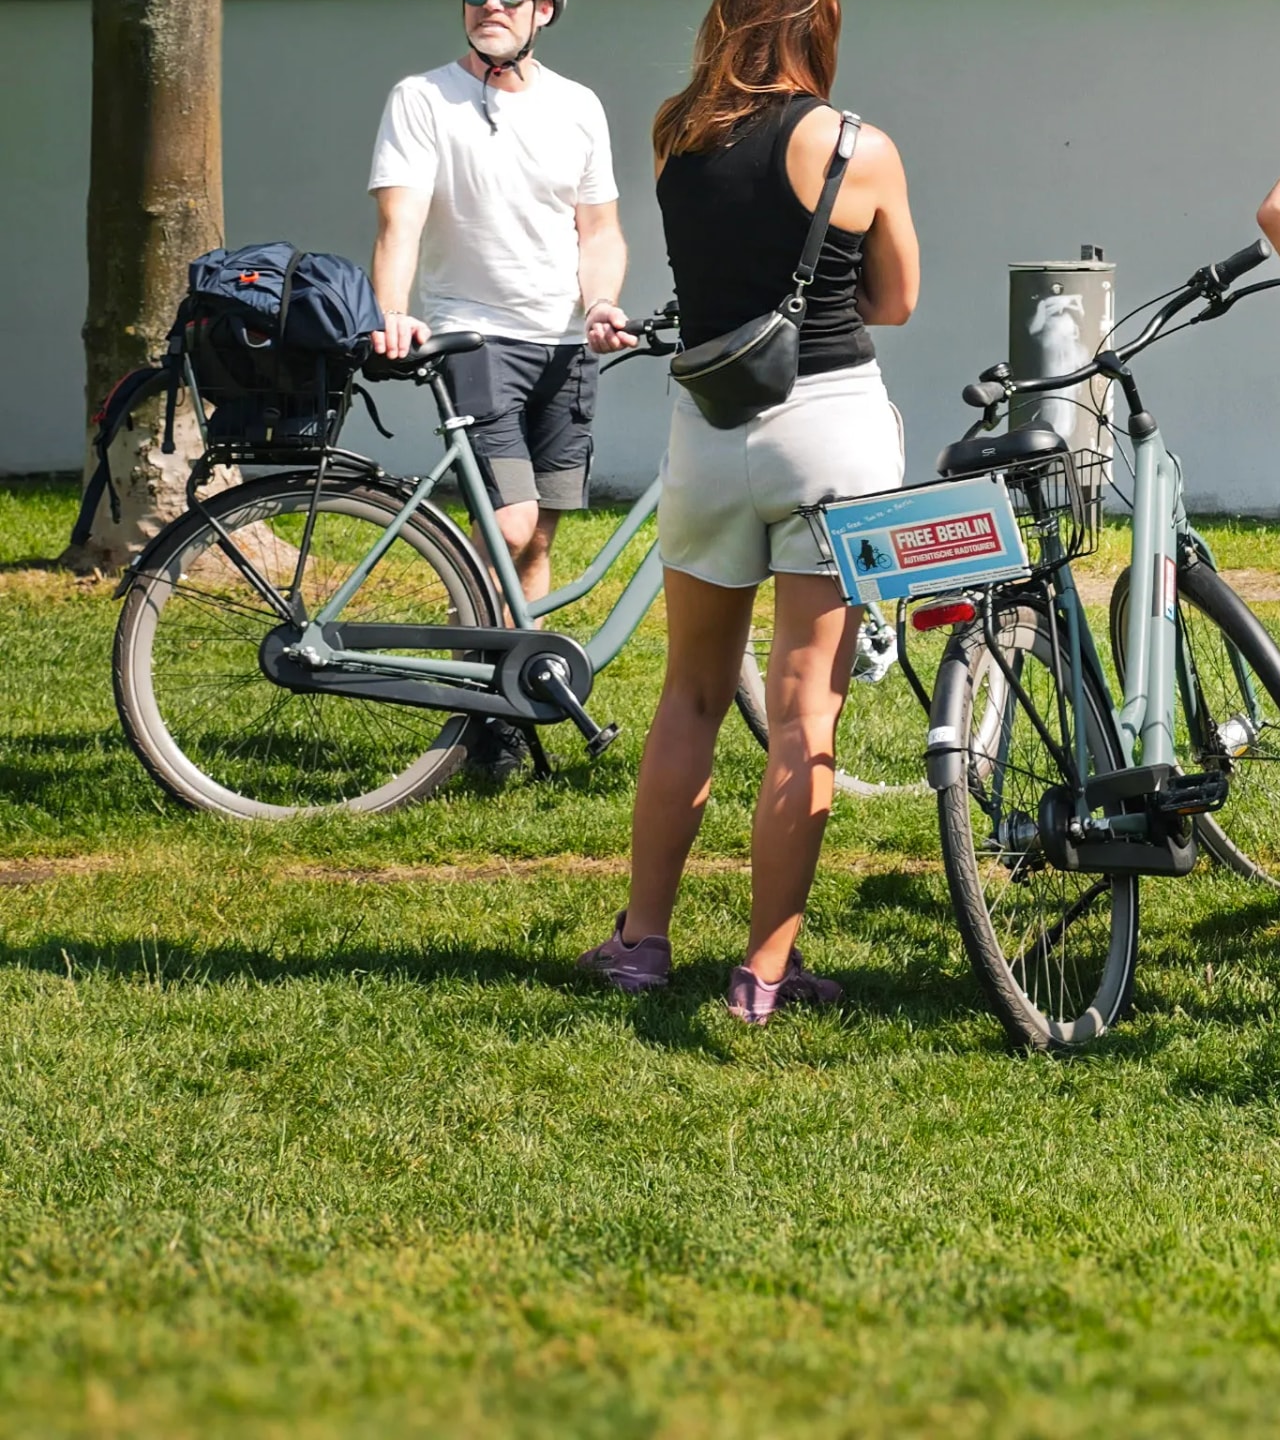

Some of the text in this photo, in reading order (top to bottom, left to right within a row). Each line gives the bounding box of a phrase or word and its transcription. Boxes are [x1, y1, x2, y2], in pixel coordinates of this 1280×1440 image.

[896, 517, 991, 550] FREE BERLIN
[903, 541, 996, 565] AUTHENTISCHE RADTOUREN
